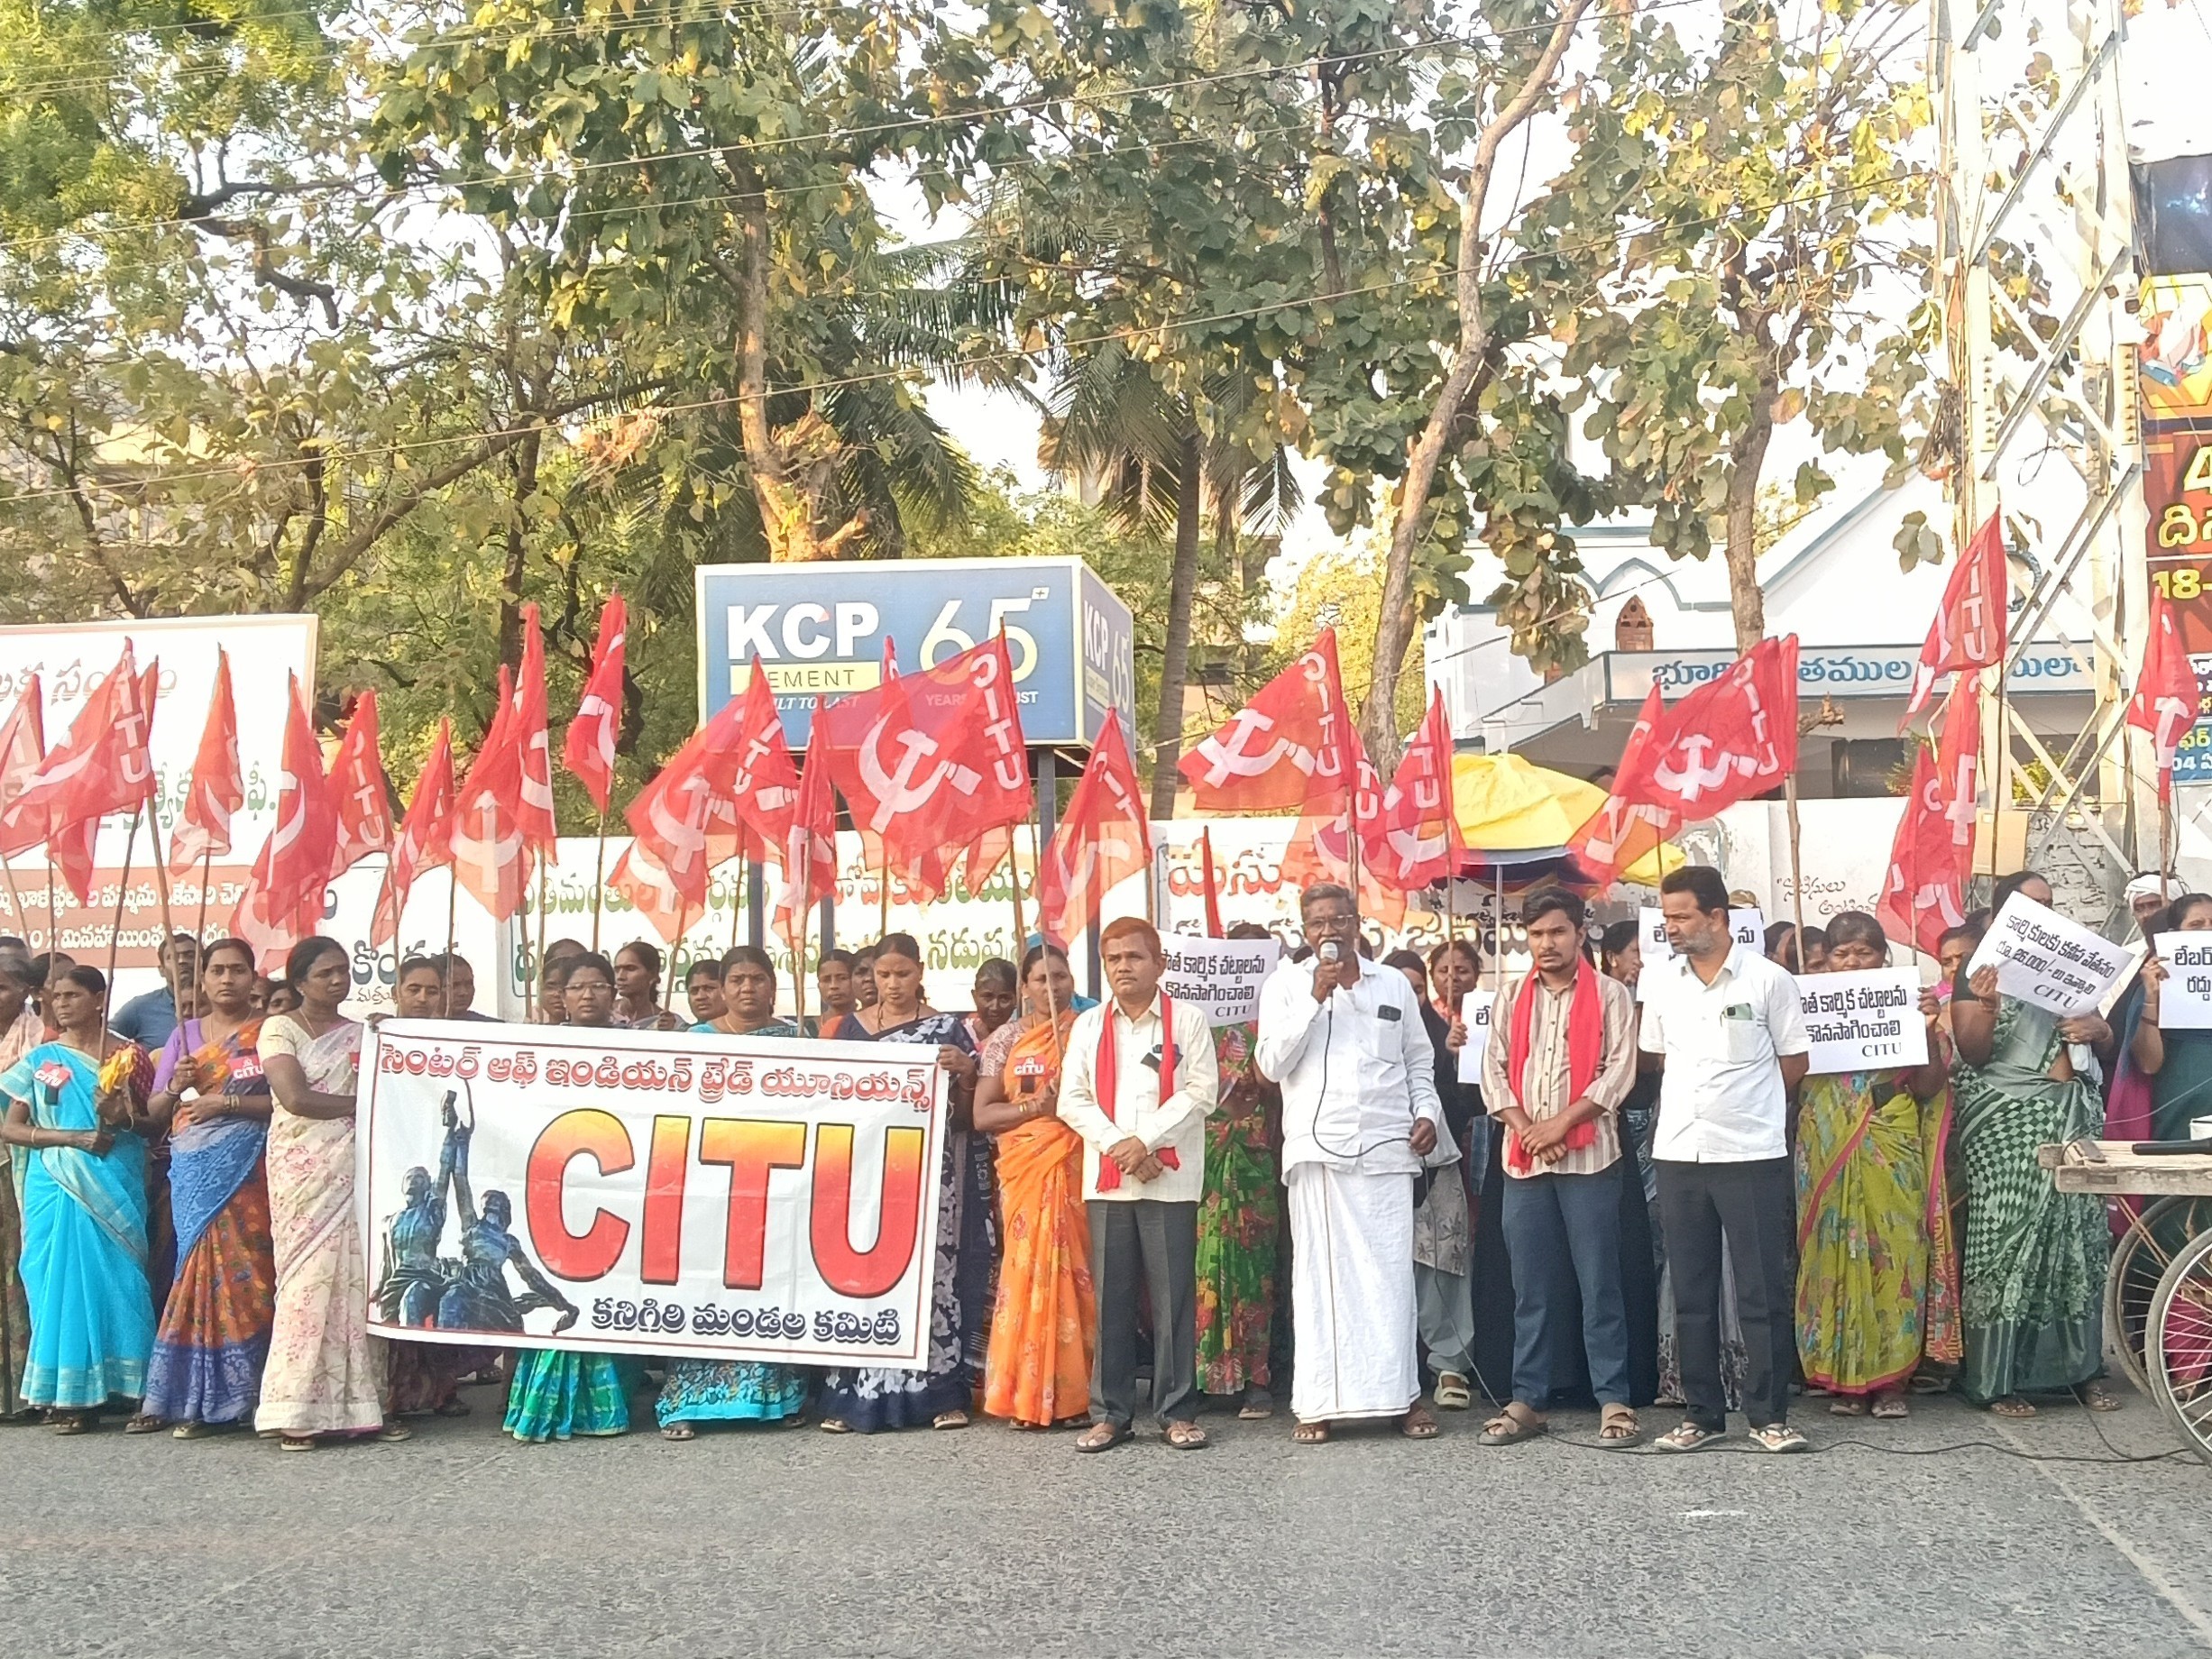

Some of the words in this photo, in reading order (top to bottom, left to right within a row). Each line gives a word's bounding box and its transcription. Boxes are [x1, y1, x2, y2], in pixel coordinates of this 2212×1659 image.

[1961, 550, 1986, 661] ITU
[727, 601, 880, 660] KCP
[1084, 600, 1109, 672] KCP
[767, 669, 855, 689] EMENT
[798, 697, 819, 710] TO
[732, 718, 783, 795] ITU
[1411, 716, 1441, 809] ITU
[1219, 954, 1265, 984] చట్టాలను
[1215, 1004, 1253, 1018] CITU
[1857, 985, 1907, 1019] చట్టాలను
[2033, 983, 2080, 1010] CITU
[1861, 1041, 1903, 1058] CITU
[381, 1043, 482, 1079] సెంటర్
[487, 1051, 538, 1088] ఆఫ్
[545, 1055, 693, 1091] ఇండియన్
[698, 1057, 754, 1104] ట్రేడ్
[760, 1067, 932, 1112] యూనియన్స్
[1013, 1063, 1045, 1076] CITU
[525, 1108, 925, 1299] CITU
[591, 1297, 686, 1335] కనిగిరి
[692, 1303, 808, 1340] మండల
